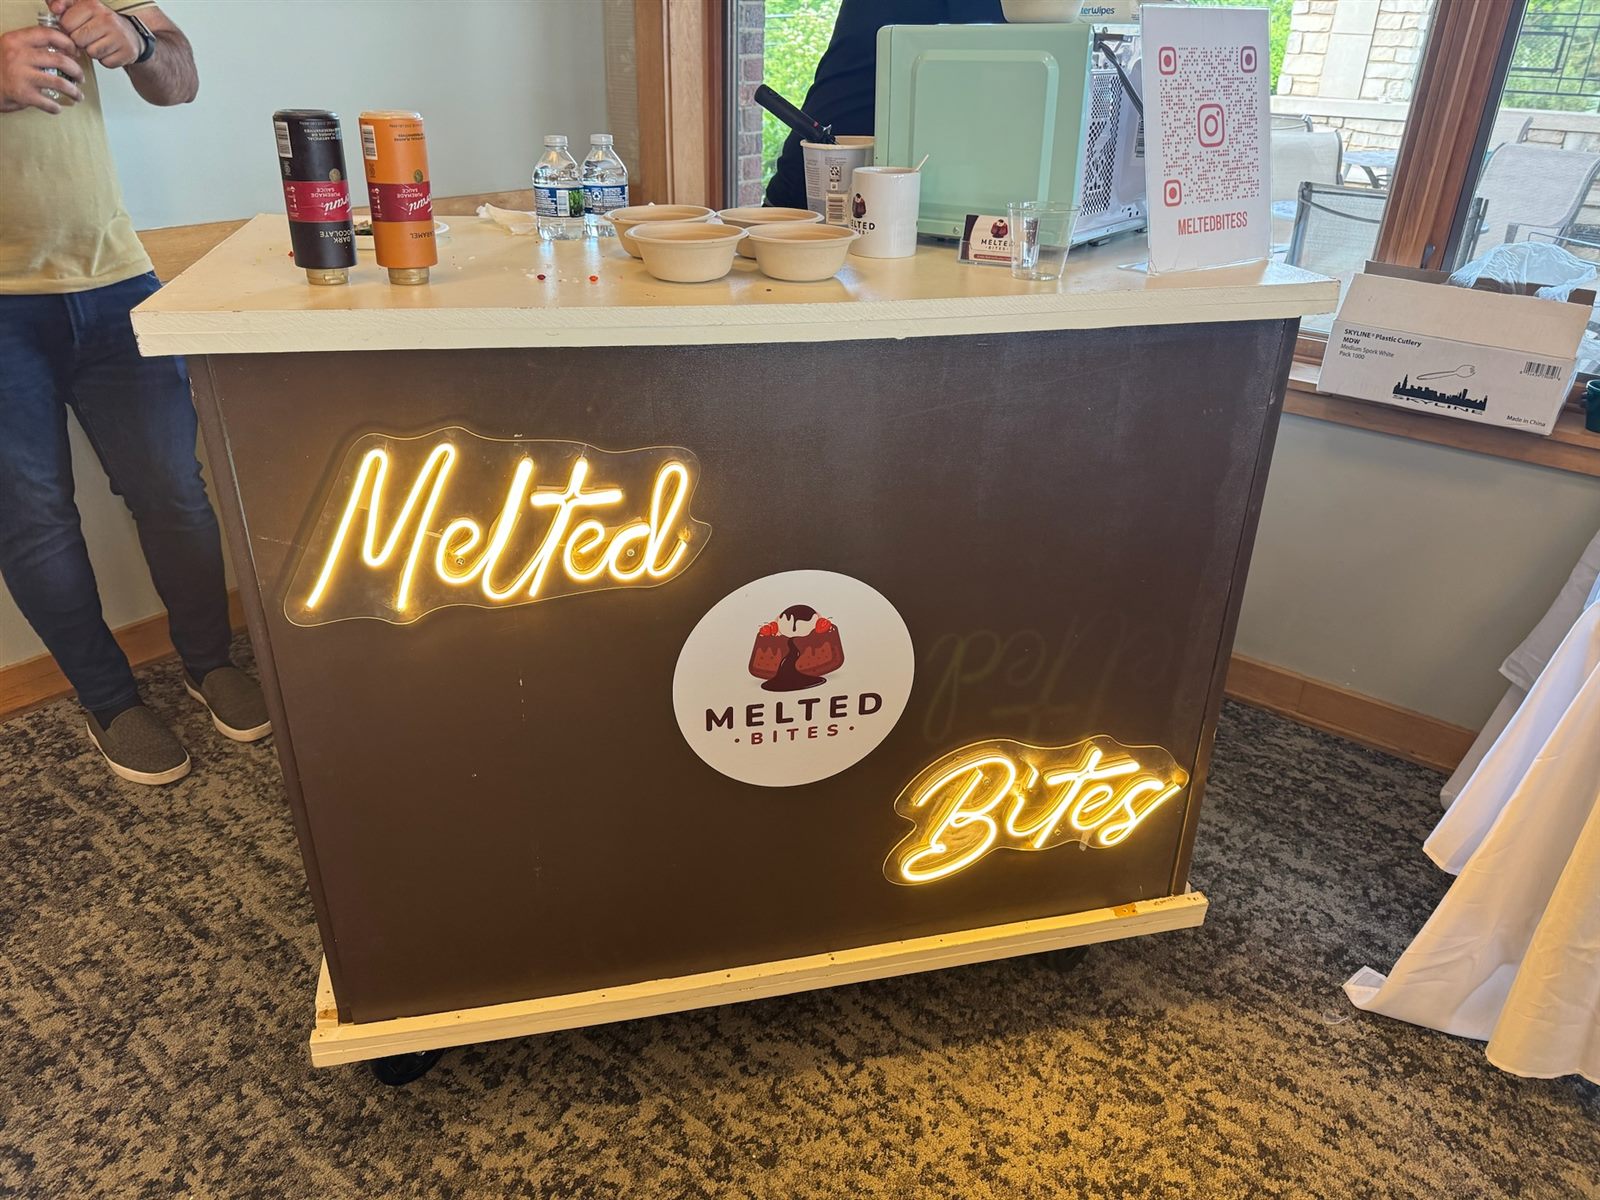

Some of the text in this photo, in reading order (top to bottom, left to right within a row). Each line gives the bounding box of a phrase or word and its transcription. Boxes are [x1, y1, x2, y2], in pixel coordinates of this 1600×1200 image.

[850, 219, 875, 231] ELTED
[1178, 211, 1248, 236] MELTEDBITESS
[319, 230, 352, 238] OCOLATE
[333, 236, 351, 244] DARK
[409, 231, 434, 239] ARAMEL
[1342, 336, 1361, 345] MDW
[1375, 333, 1397, 343] Plastic
[1397, 337, 1422, 348] Cutlery
[1339, 350, 1351, 358] Pack
[1341, 343, 1362, 352] Medium
[1379, 350, 1395, 358] White
[1392, 394, 1483, 416] SKYLINE
[1506, 415, 1522, 423] Made
[1530, 419, 1546, 427] China
[305, 442, 690, 612] Melted
[705, 692, 883, 732] MELTED
[750, 724, 839, 745] BITES
[901, 744, 1183, 882] Bites
